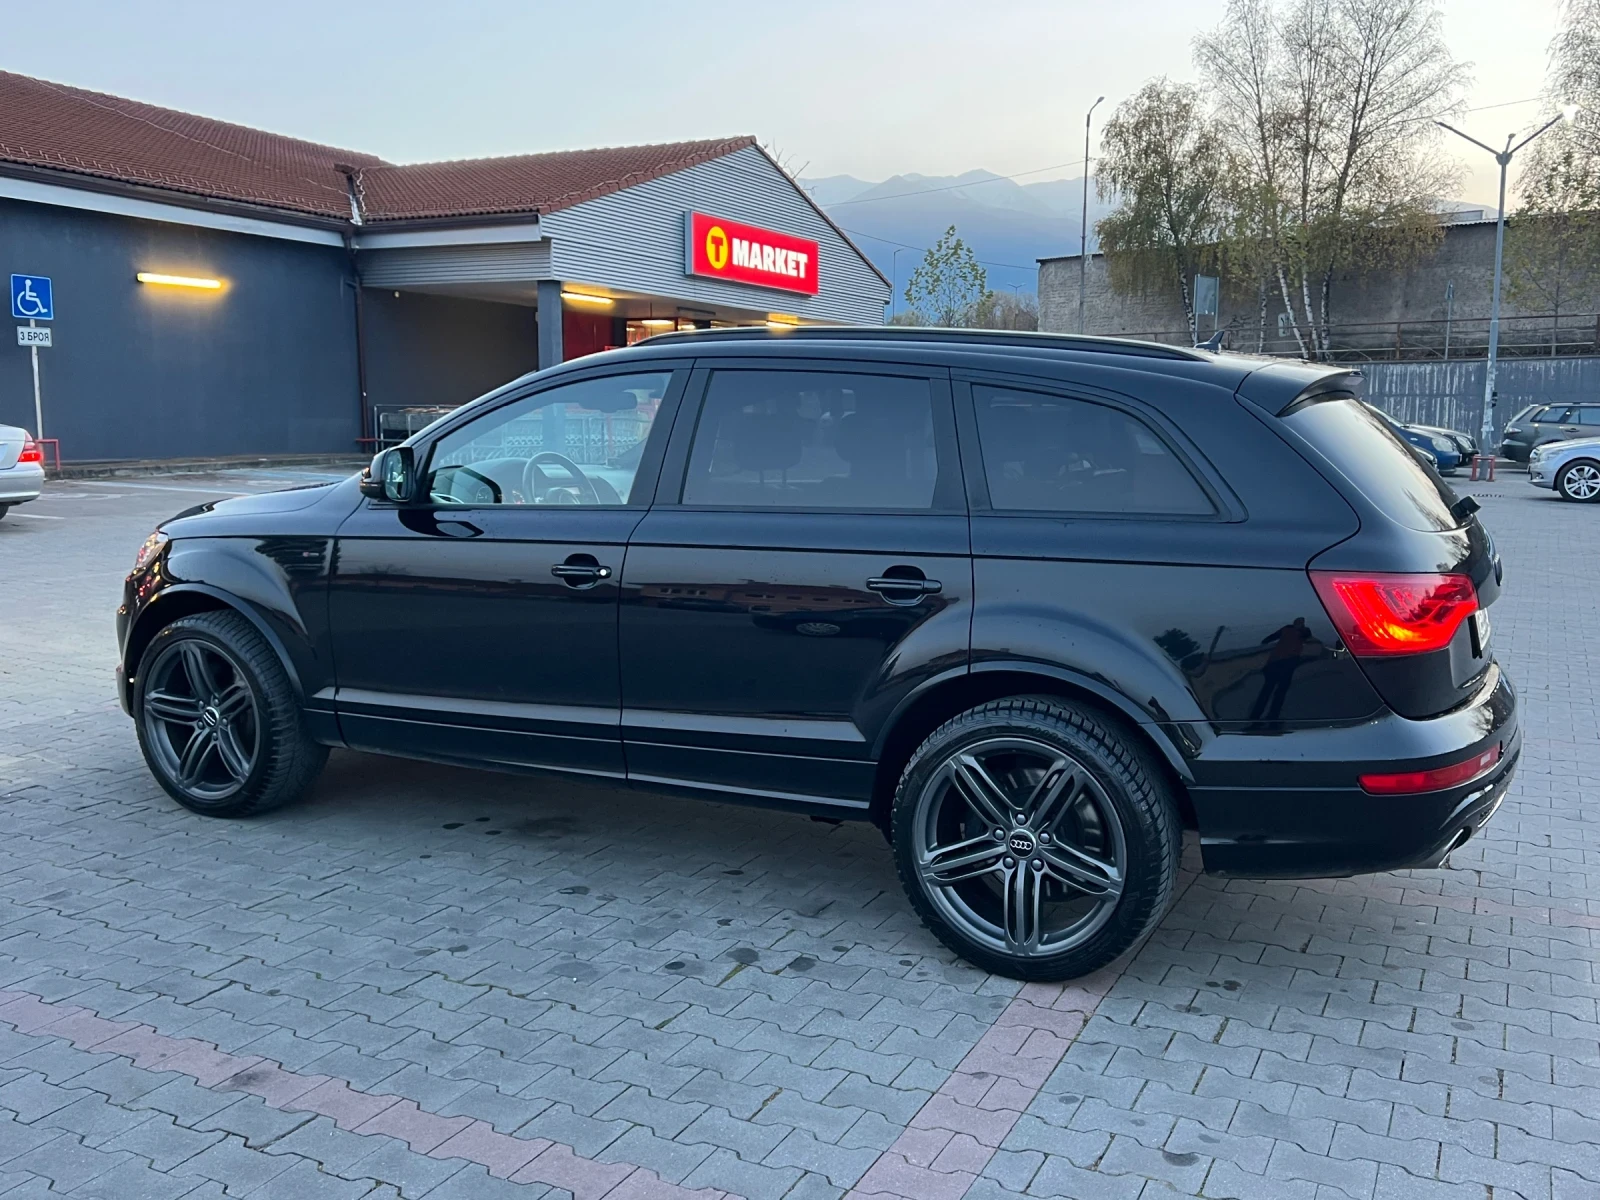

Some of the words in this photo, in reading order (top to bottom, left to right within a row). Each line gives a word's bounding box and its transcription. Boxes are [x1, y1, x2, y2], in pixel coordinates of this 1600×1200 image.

[711, 235, 723, 262] T
[732, 237, 808, 279] MARKET
[20, 331, 25, 341] 3
[27, 331, 50, 342] БРОЯ
